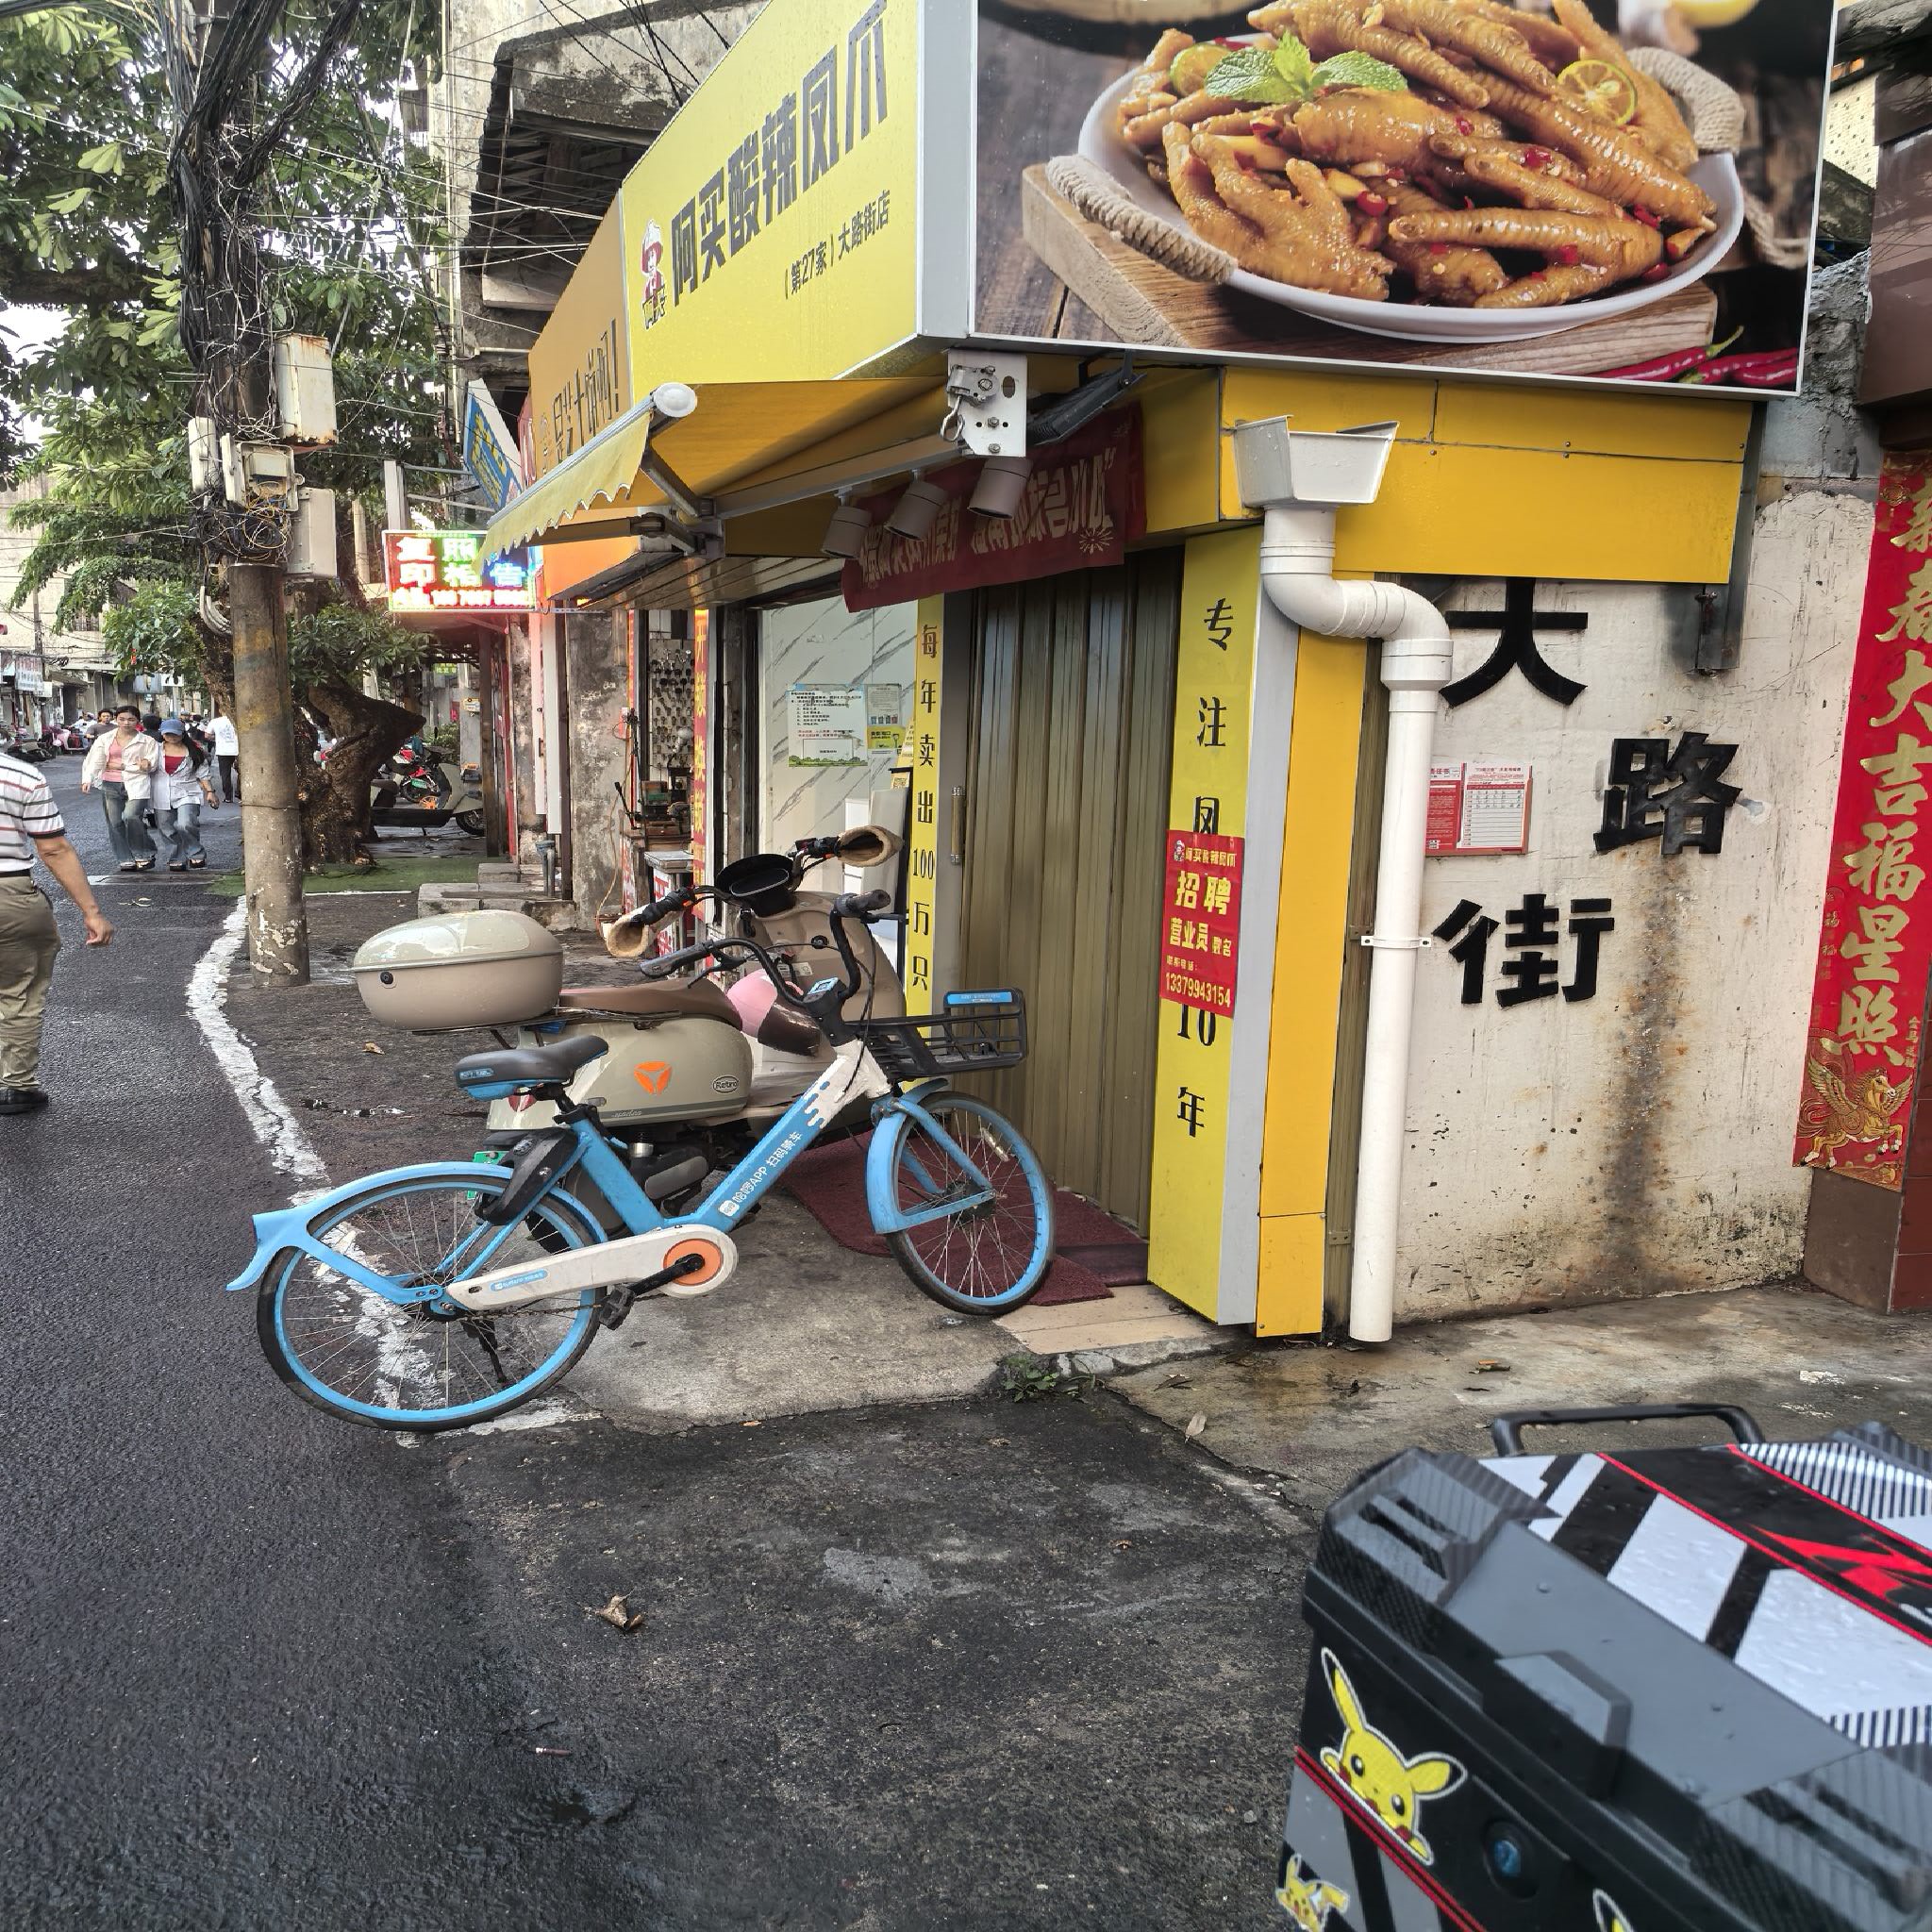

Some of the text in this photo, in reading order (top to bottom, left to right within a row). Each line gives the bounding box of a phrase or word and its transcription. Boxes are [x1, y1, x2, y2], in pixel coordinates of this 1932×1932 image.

[670, 0, 889, 308] 阿买酸辣凤爪
[1174, 870, 1232, 916] 招聘
[1169, 917, 1208, 952] 营业员
[1165, 972, 1231, 1008] 13379943154
